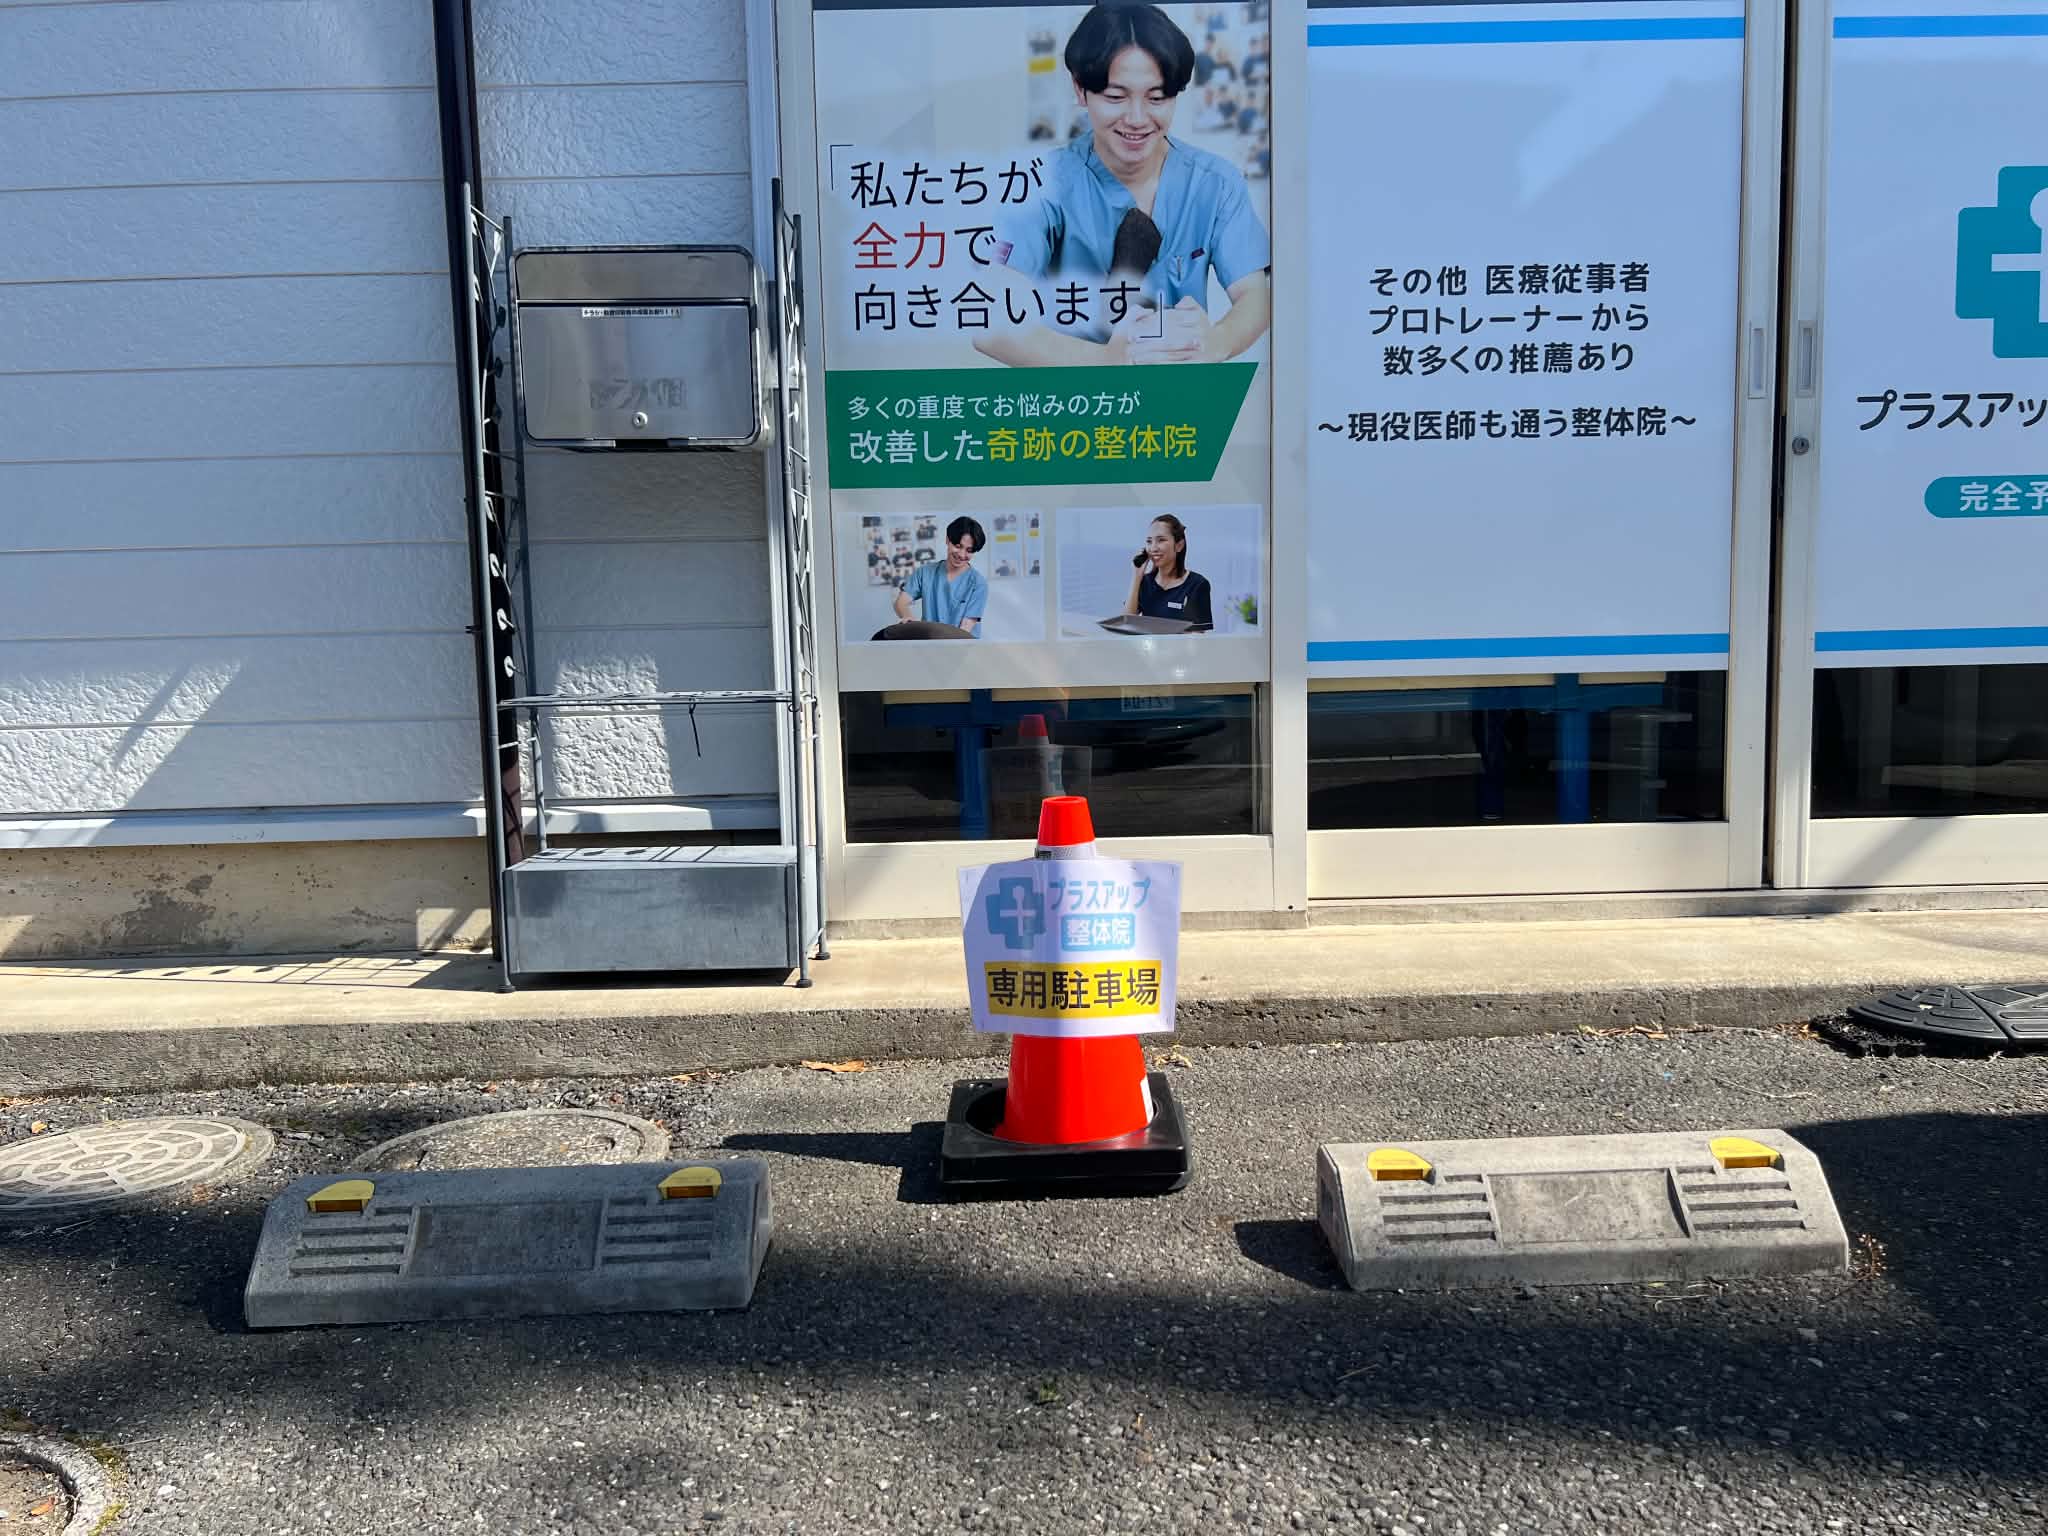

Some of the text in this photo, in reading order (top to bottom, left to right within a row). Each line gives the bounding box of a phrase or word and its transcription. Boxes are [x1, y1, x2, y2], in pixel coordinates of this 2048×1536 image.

[852, 221, 996, 270] 全力で
[1369, 261, 1650, 296] その他 医療従事者
[1369, 303, 1649, 335] プロトレーナーから
[1383, 342, 1634, 376] 数多くの推薦あり
[848, 391, 1141, 420] 多くの重度でお悩みの方が
[849, 424, 1197, 464] 改善した奇跡の整体院
[1047, 877, 1152, 911] プラスアップ
[1067, 918, 1132, 946] 整体院
[987, 967, 1160, 1010] 専用駐車場
